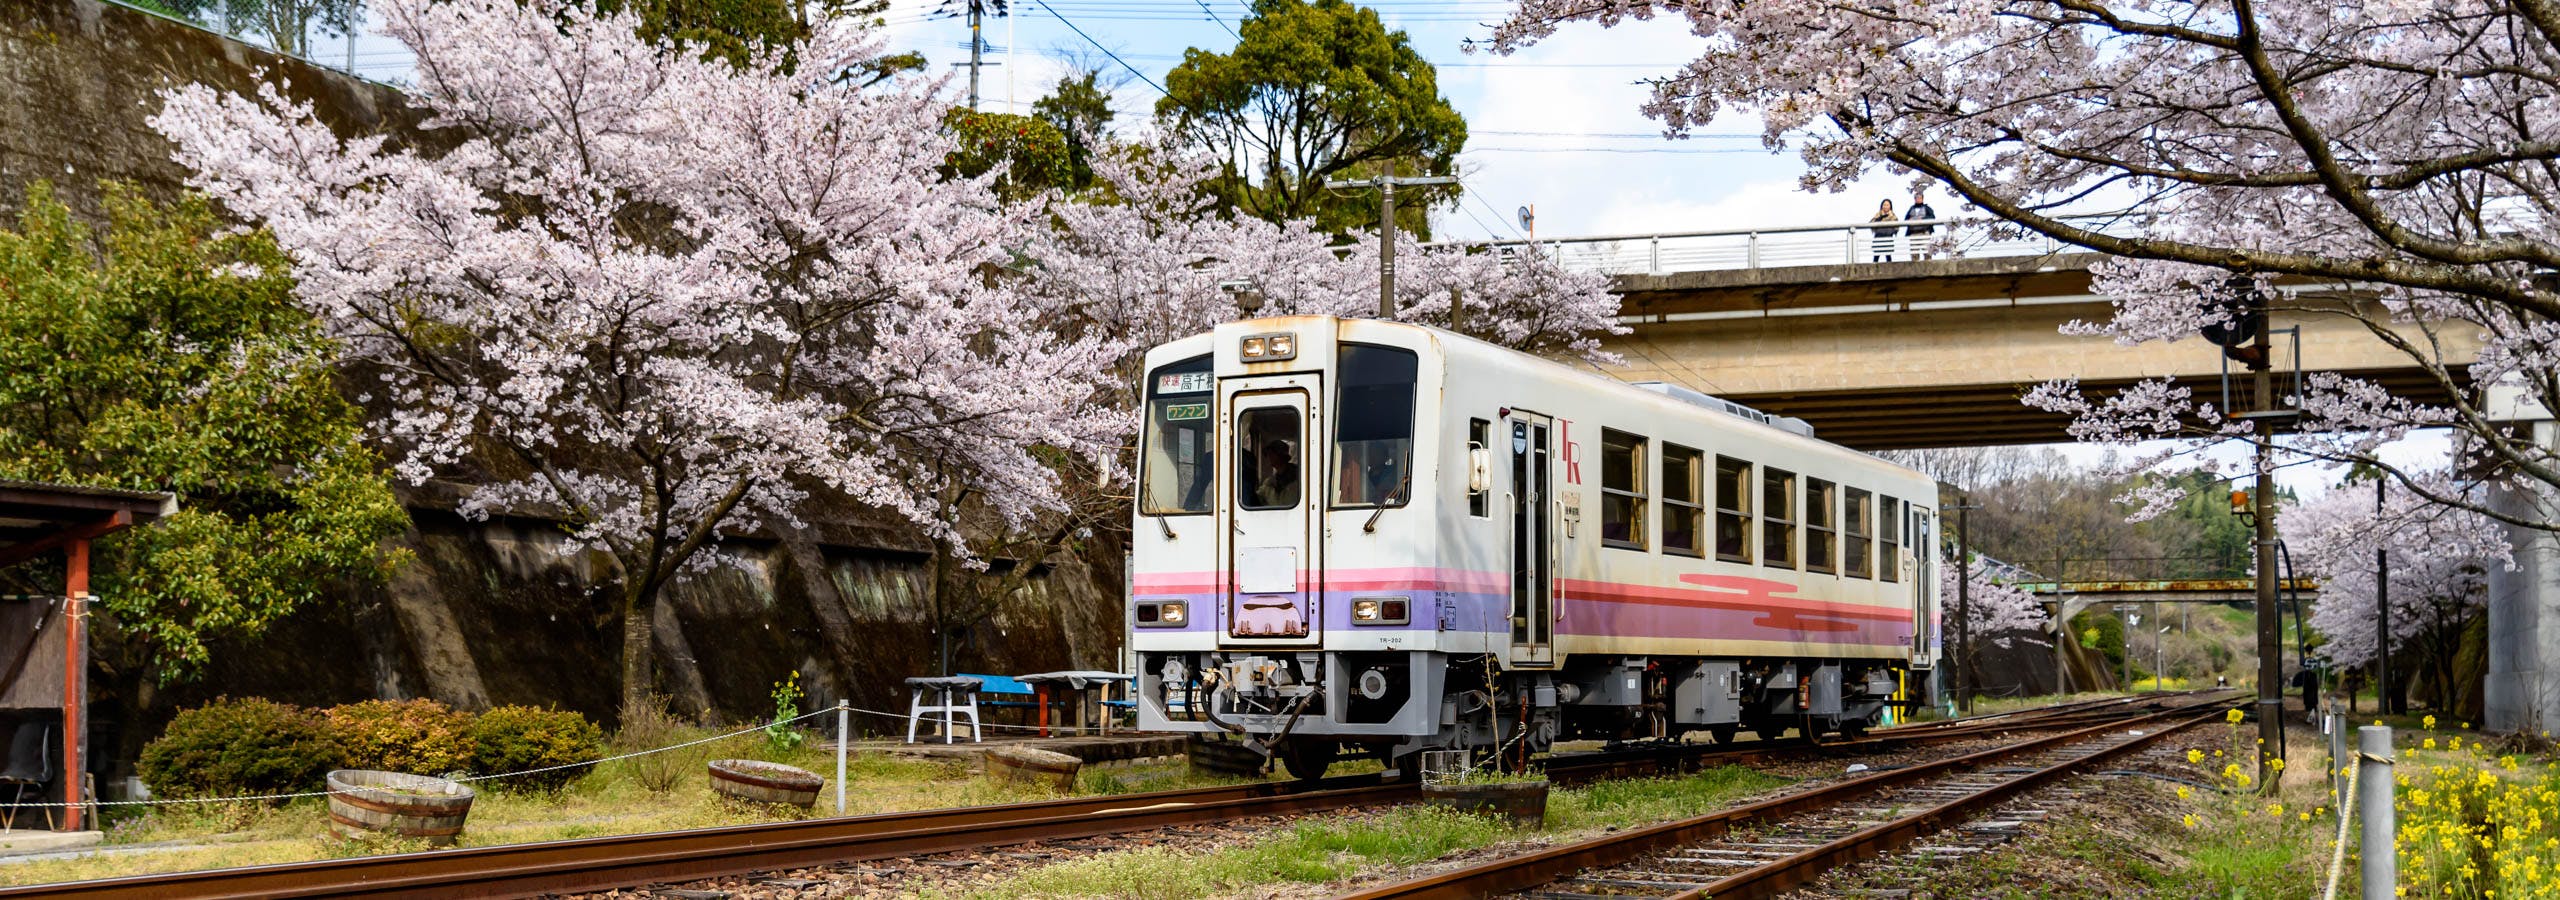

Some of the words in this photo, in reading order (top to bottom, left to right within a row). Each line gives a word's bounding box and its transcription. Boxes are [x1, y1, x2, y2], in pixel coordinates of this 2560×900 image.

[1168, 406, 1205, 418] ワンマン
[1557, 418, 1581, 485] TR
